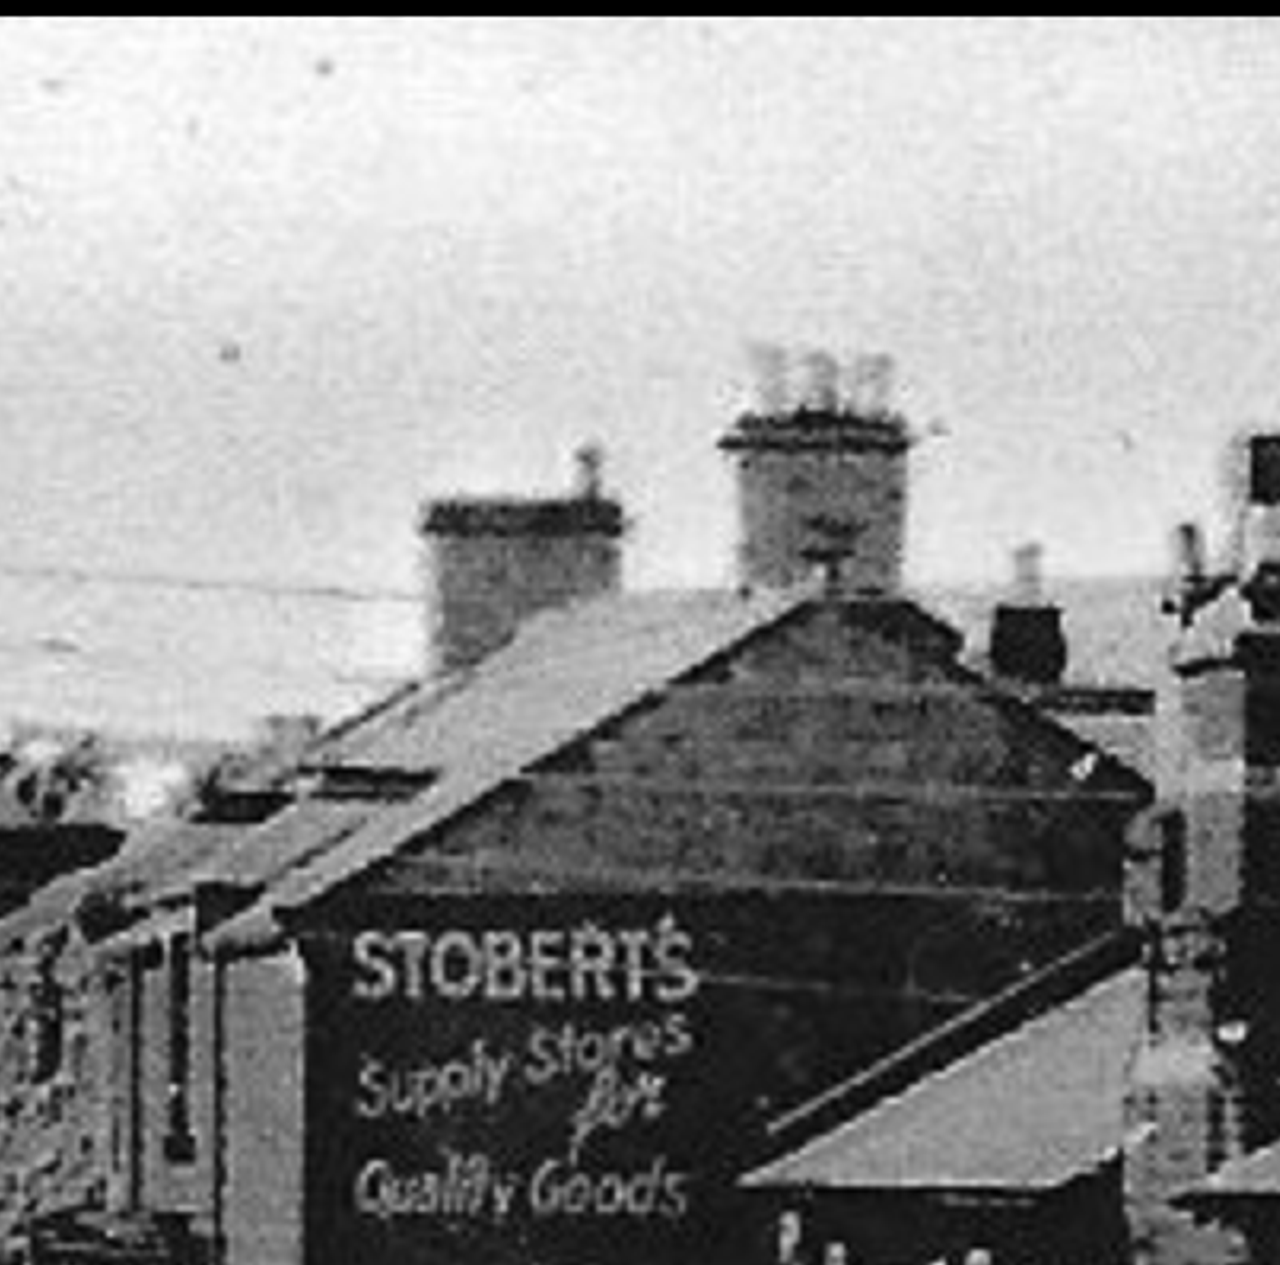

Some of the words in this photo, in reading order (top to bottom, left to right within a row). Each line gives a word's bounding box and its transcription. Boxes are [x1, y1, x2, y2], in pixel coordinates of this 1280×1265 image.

[352, 912, 700, 1000] STOBERT'S
[358, 1038, 512, 1118] Supply
[524, 1014, 694, 1083] Stores
[355, 1152, 515, 1219] Quality
[529, 1156, 688, 1216] Goods
